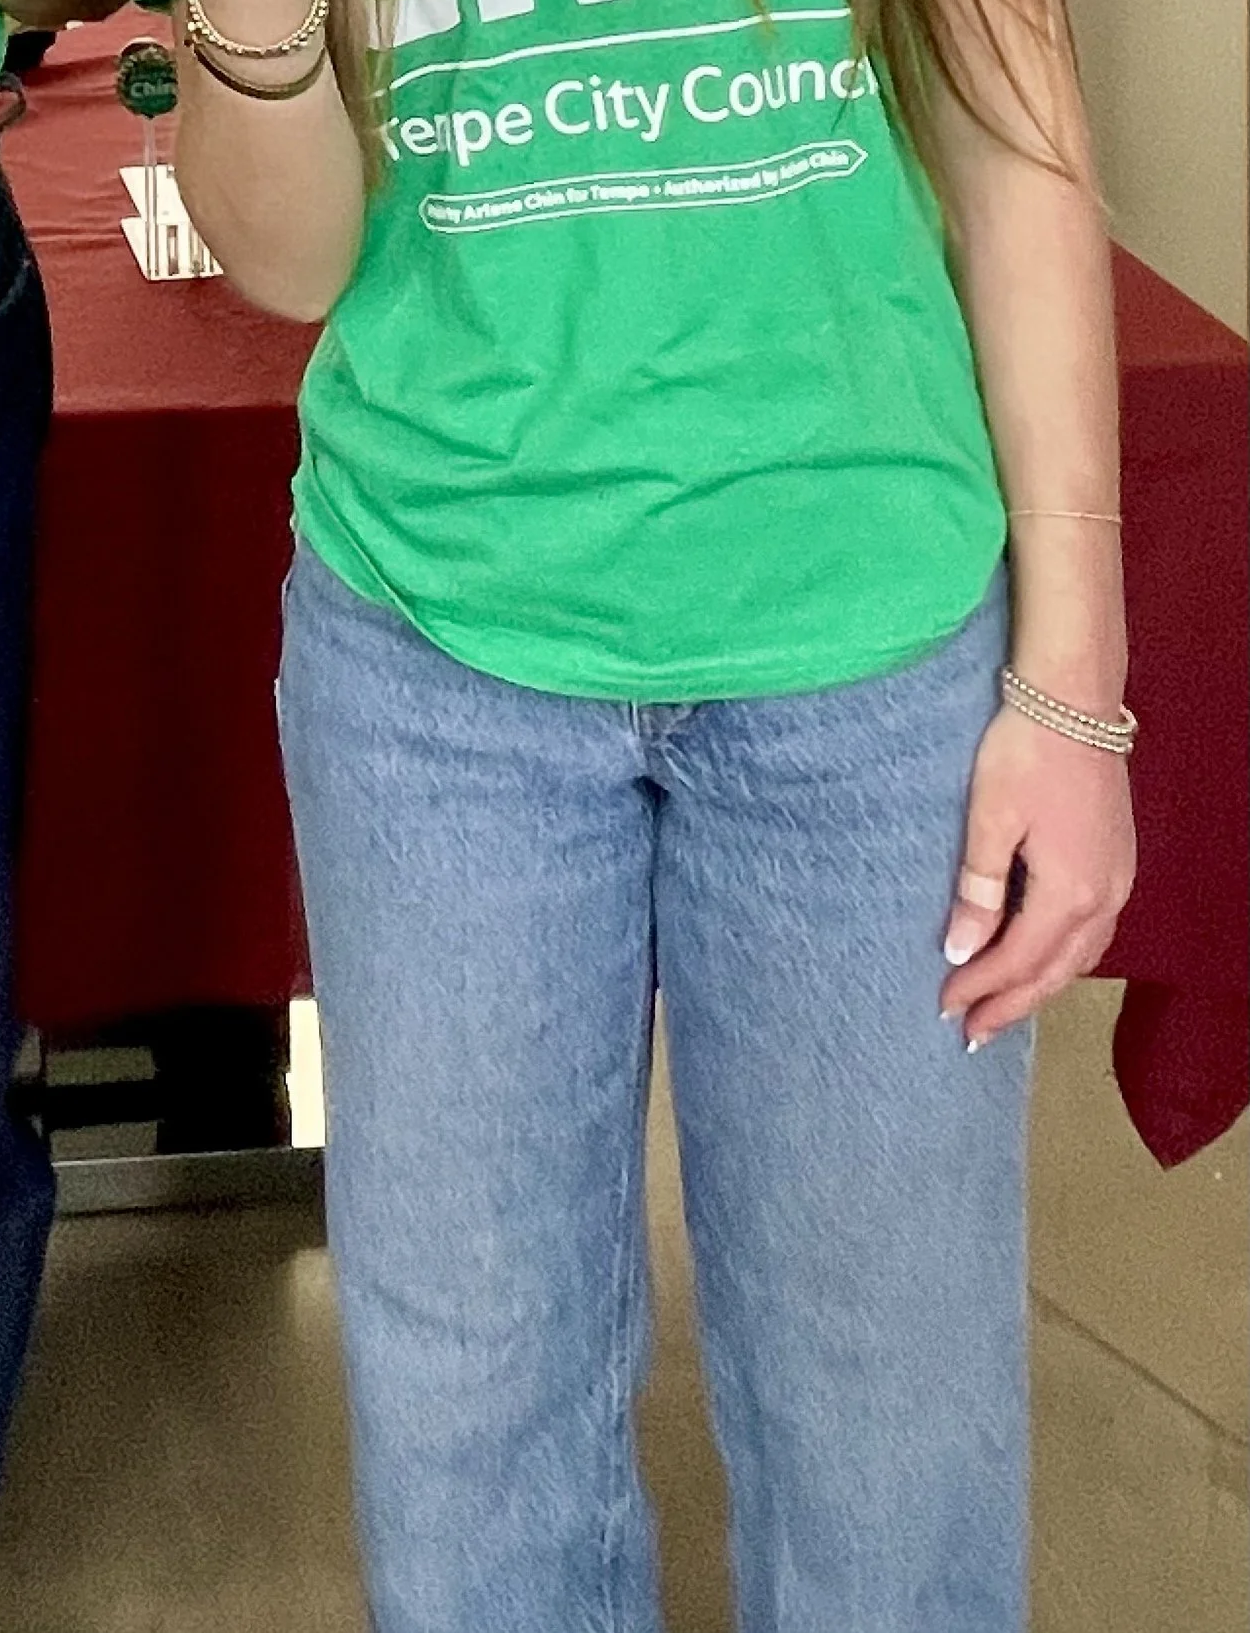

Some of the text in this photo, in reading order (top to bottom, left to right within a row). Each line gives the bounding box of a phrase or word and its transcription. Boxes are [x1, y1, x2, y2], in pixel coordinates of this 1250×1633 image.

[545, 75, 669, 142] City
[683, 55, 879, 122] Counci
[524, 190, 566, 210] Chin
